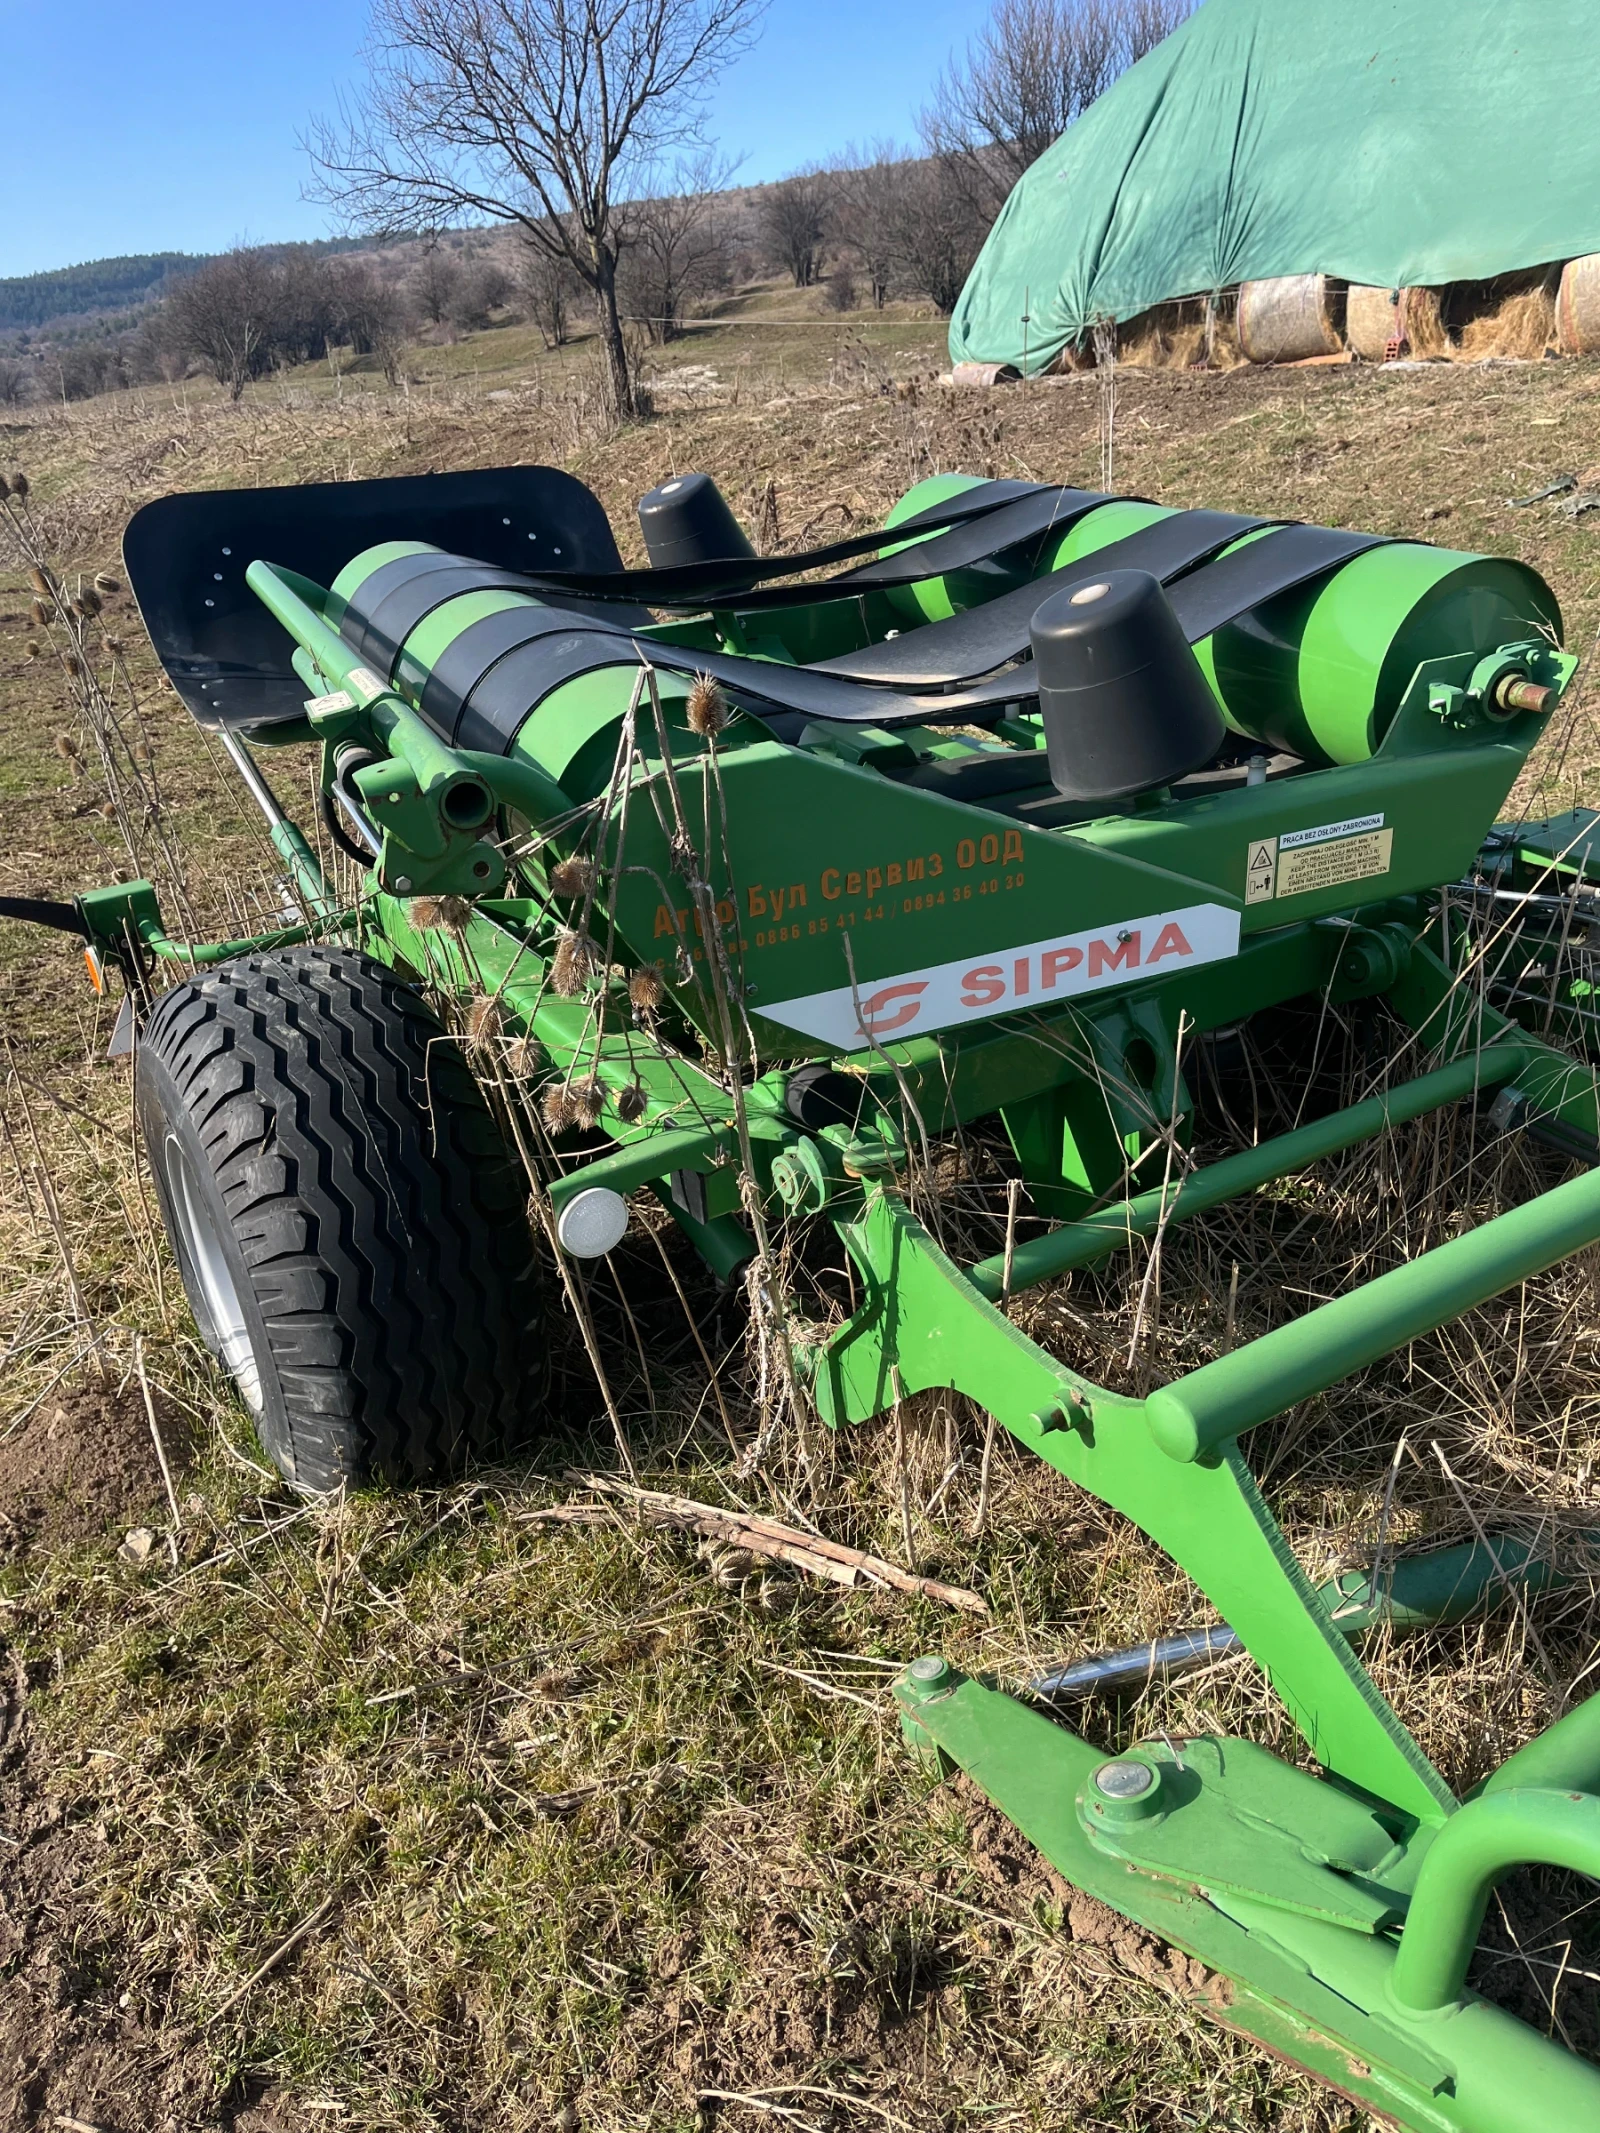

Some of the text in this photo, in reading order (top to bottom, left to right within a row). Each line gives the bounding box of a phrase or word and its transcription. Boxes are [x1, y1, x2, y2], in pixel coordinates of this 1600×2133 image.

[1283, 835, 1303, 845] PRACA
[1304, 832, 1316, 840] BEZ
[1342, 817, 1381, 831] ZABRONIONA
[748, 884, 807, 922] Бул
[821, 853, 943, 900] Сервиз
[956, 829, 1024, 869] ООД
[1296, 870, 1314, 879] LEAST
[1315, 866, 1330, 874] FROM
[1360, 866, 1387, 877] BEHALTEN
[756, 924, 800, 947] 0886
[808, 917, 828, 935] 85
[836, 912, 856, 928] 41
[864, 905, 884, 922] 44
[903, 891, 945, 913] 0894
[953, 885, 972, 902] 36
[979, 879, 998, 895] 40
[1006, 873, 1024, 889] 30
[960, 922, 1194, 1008] SIPMA
